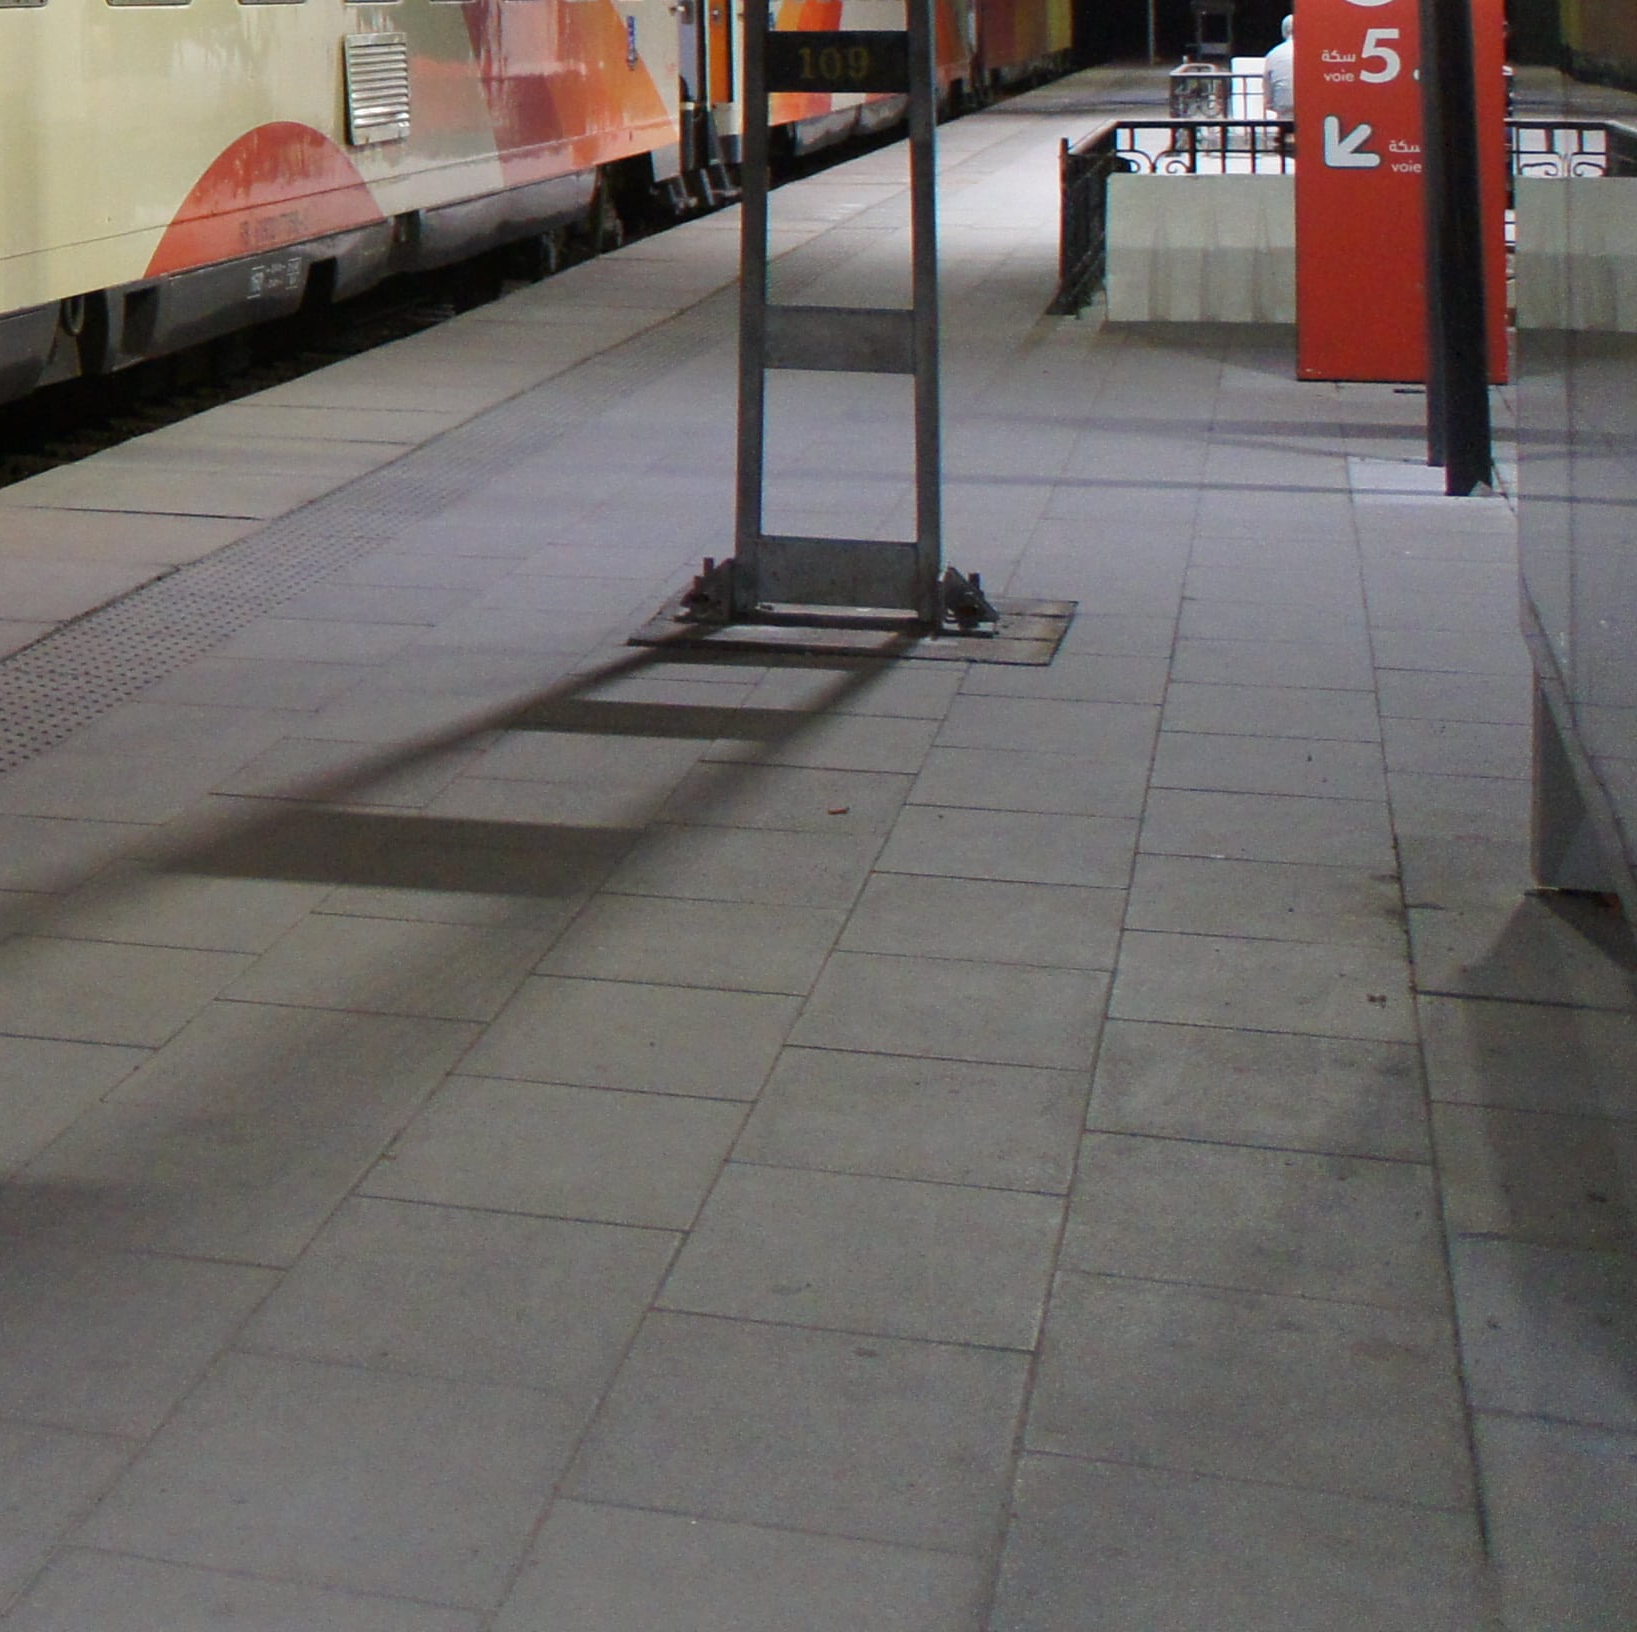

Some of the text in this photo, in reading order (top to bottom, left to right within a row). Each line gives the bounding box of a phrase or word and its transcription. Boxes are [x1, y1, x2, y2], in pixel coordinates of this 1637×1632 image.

[1321, 49, 1356, 63] سكة
[1359, 28, 1401, 83] 5
[798, 47, 870, 80] 109
[1323, 69, 1355, 82] voie
[1391, 160, 1422, 173] voie
